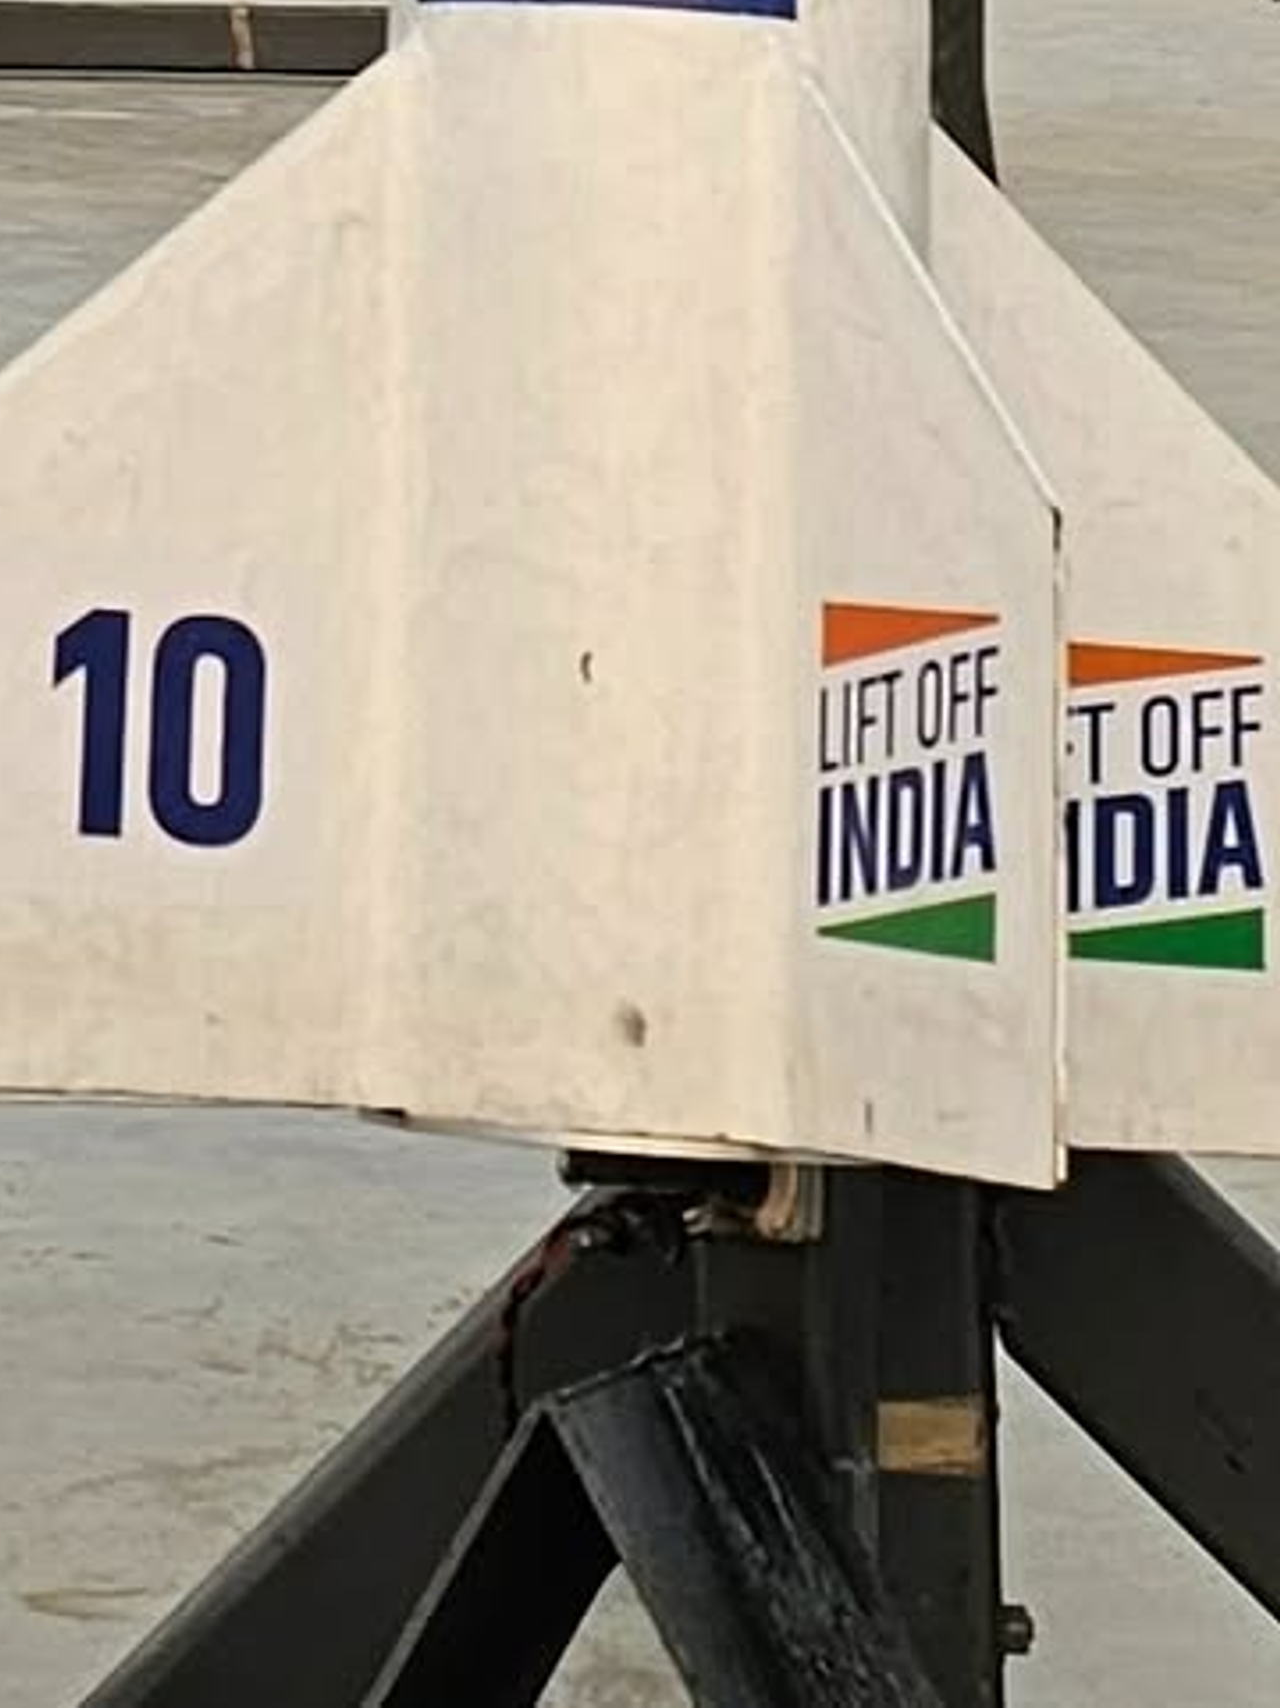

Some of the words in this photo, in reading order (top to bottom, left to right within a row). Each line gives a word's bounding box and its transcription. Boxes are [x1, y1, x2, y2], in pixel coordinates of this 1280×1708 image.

[52, 609, 267, 848] 10
[820, 670, 903, 773] LIFT
[917, 646, 1000, 750] OFF
[1140, 684, 1264, 777] OFF
[816, 750, 997, 907] INDIA
